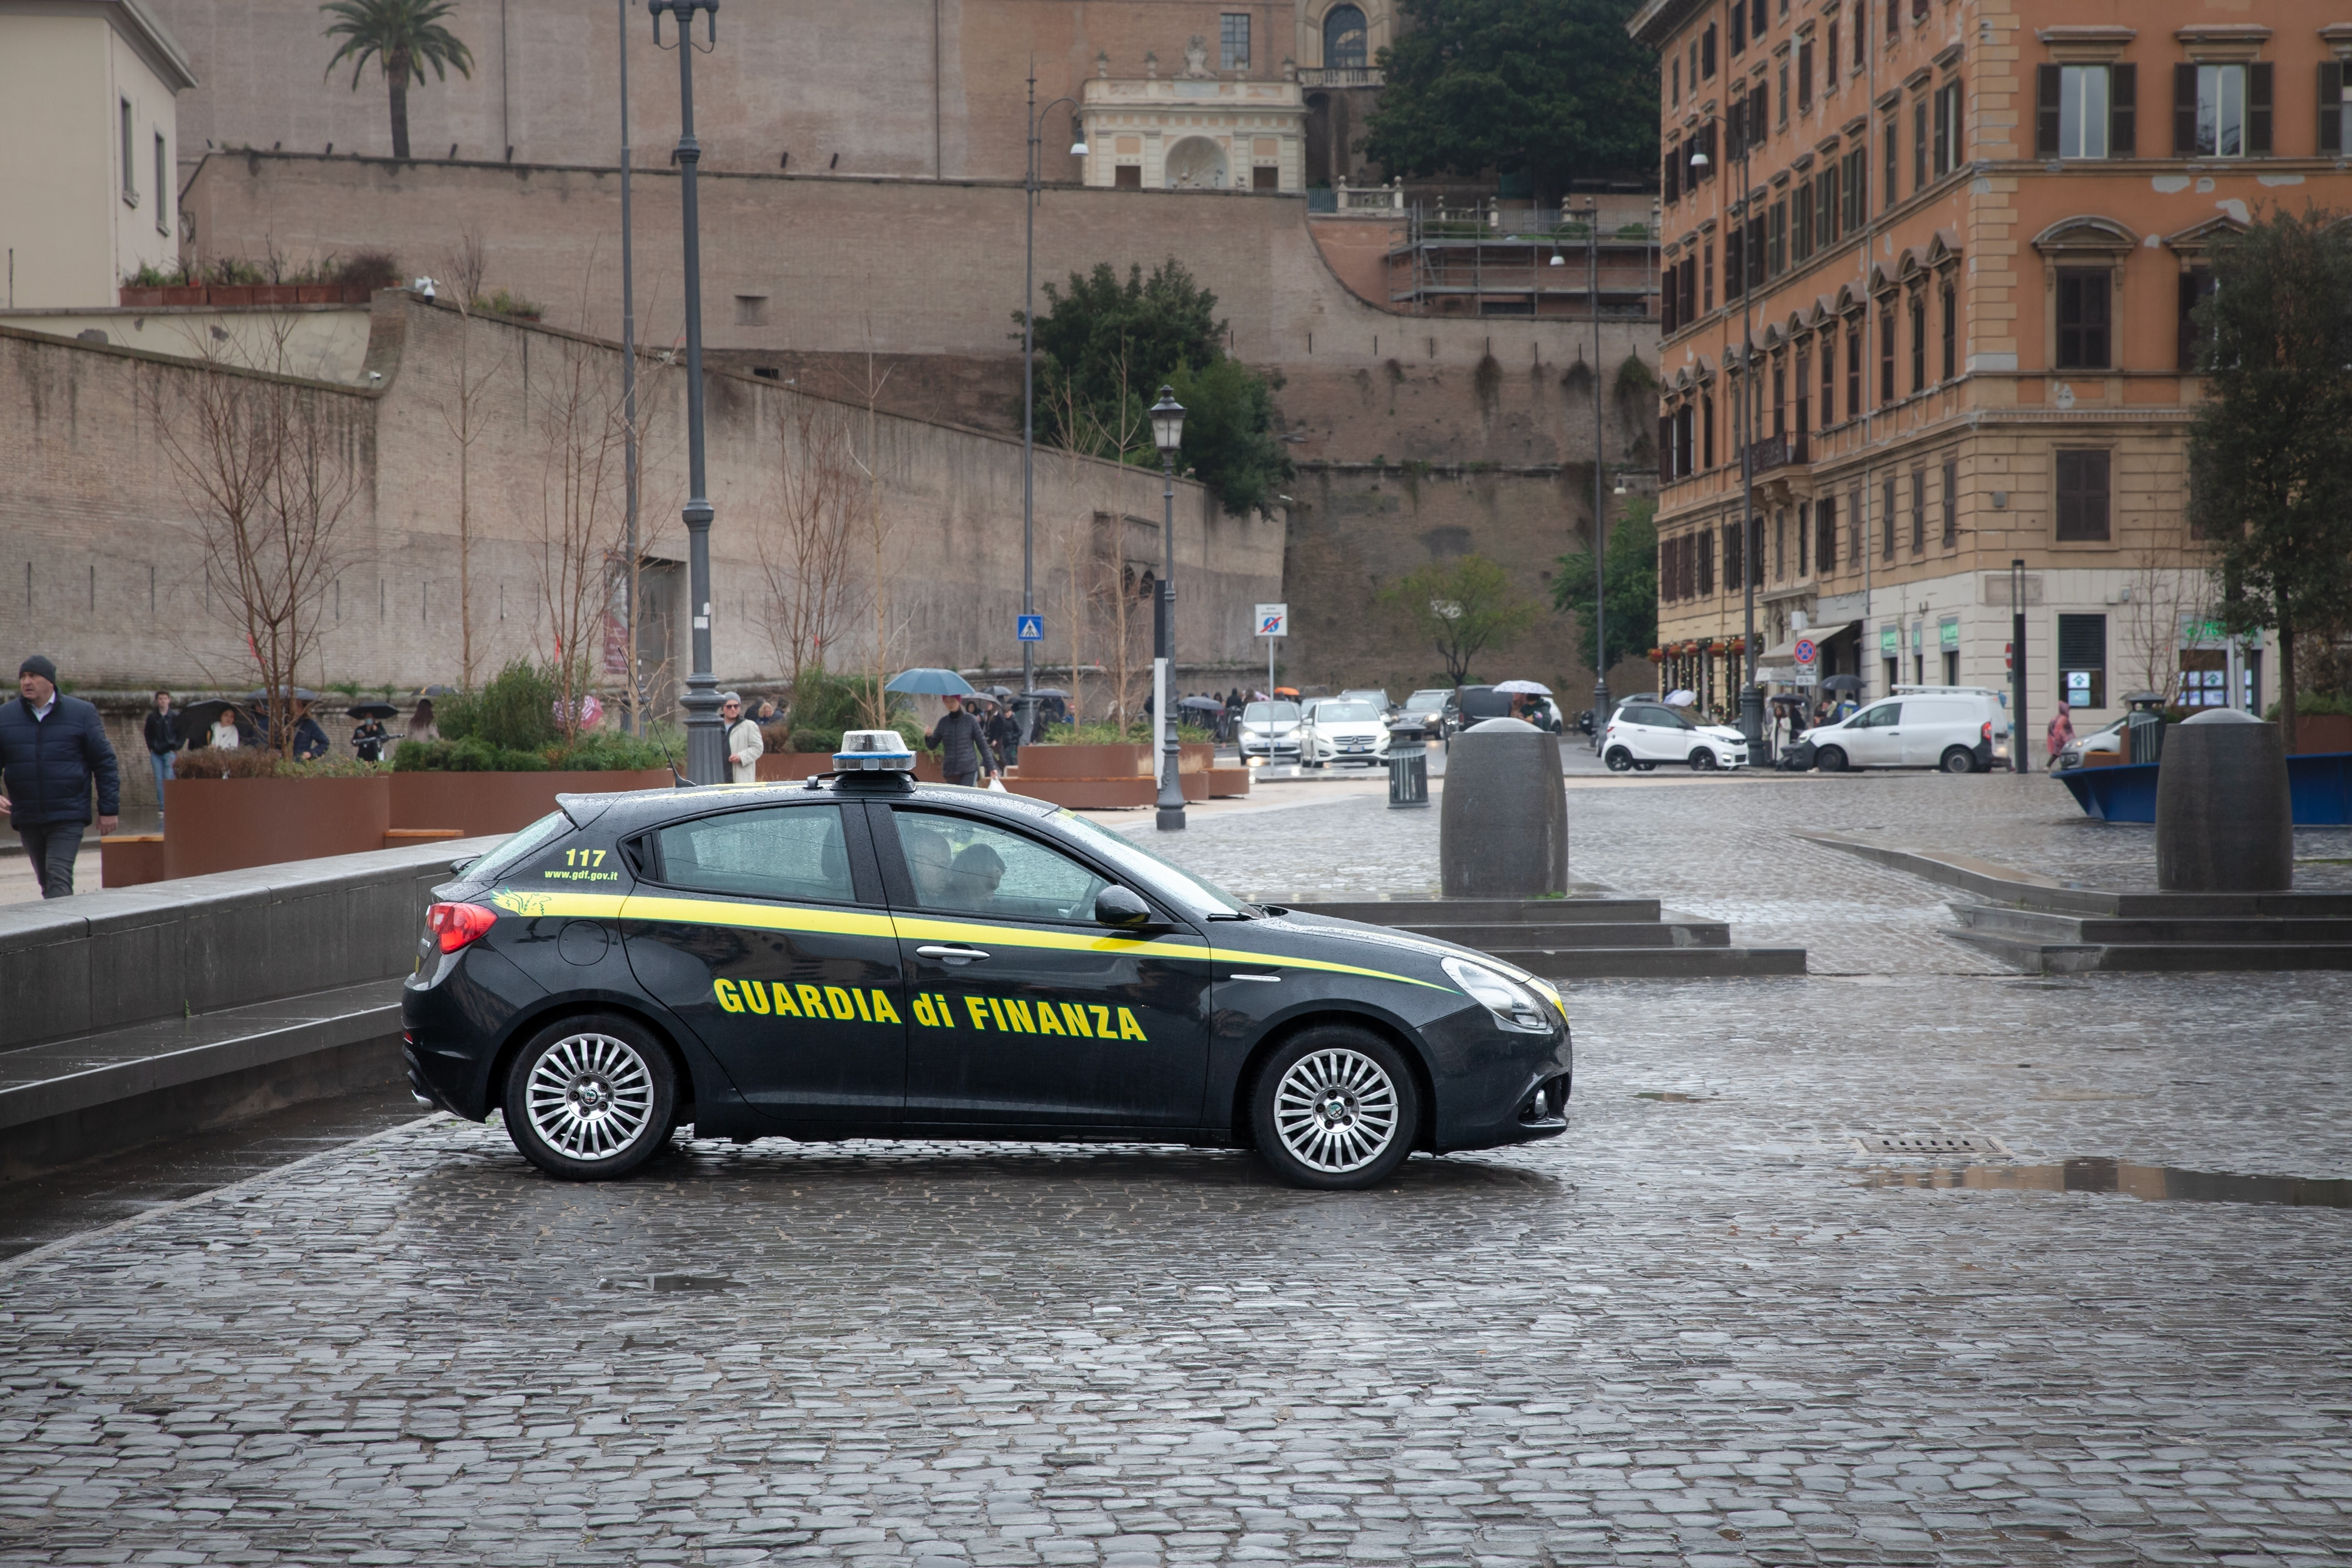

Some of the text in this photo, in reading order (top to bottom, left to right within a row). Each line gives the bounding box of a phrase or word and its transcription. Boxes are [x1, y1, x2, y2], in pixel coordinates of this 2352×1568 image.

[566, 848, 606, 867] 117
[544, 870, 619, 881] www.gdf.gov.it
[713, 978, 1148, 1042] GUARDIA di FINANZA
